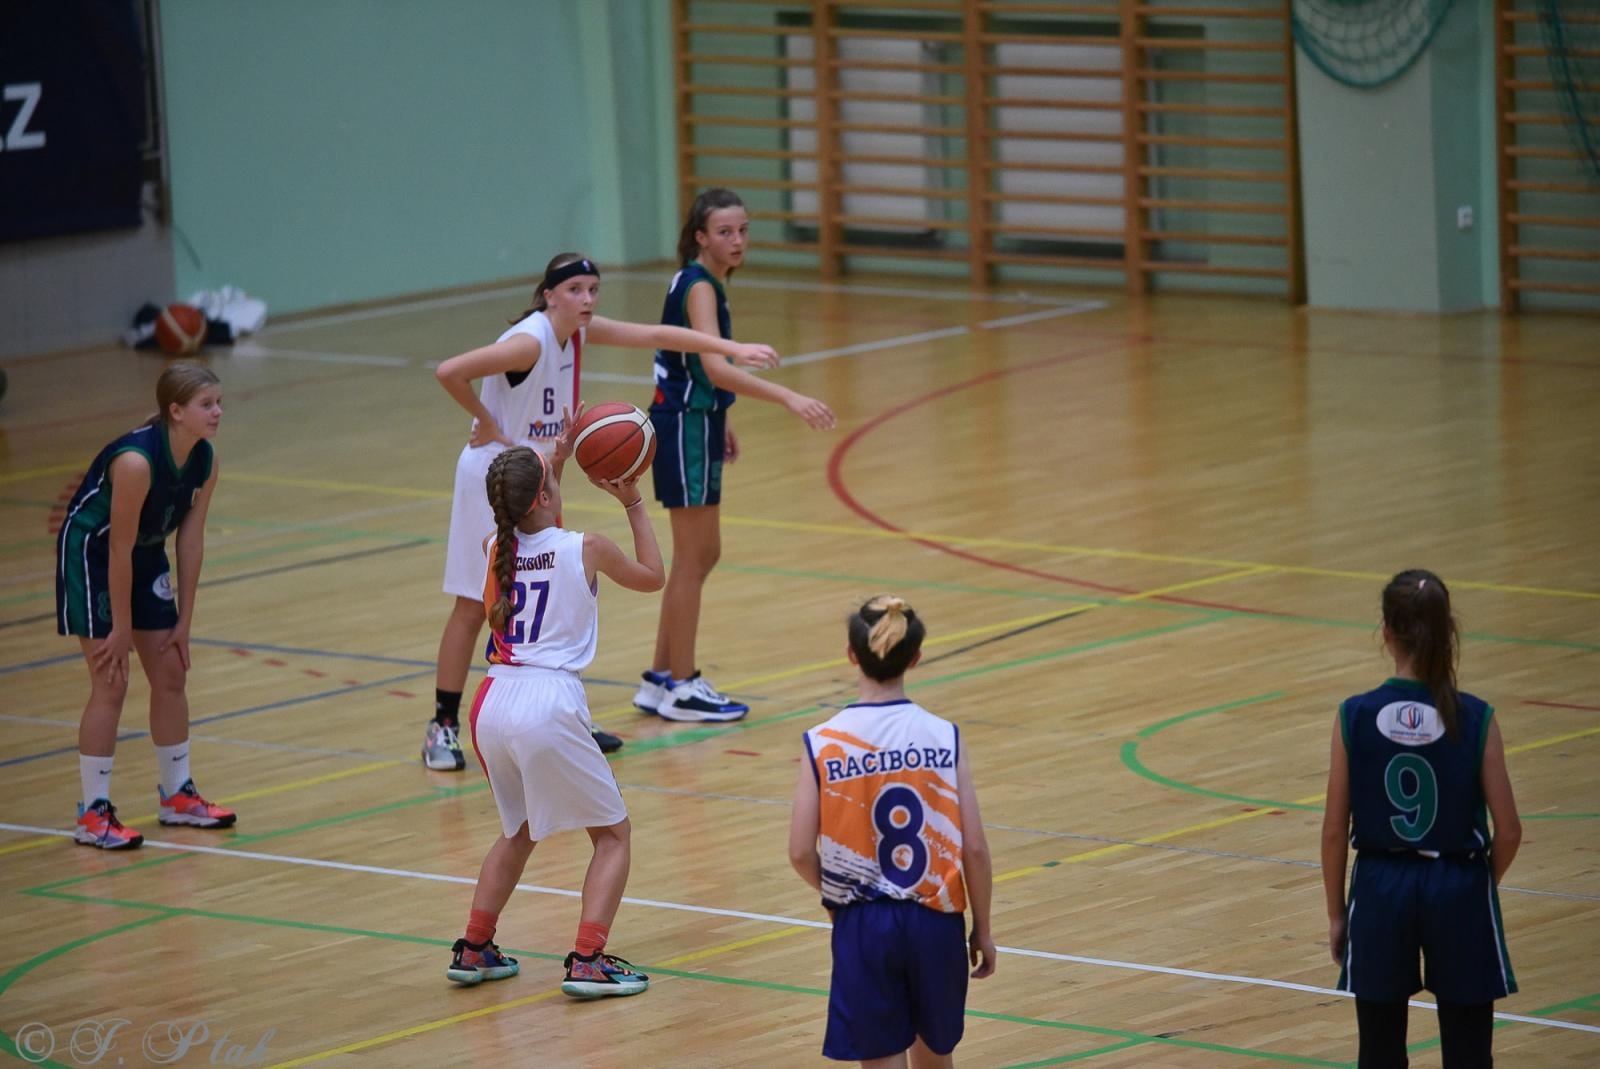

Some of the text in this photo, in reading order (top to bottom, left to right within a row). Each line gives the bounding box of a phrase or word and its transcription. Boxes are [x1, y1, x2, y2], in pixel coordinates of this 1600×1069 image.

[0, 82, 46, 151] Z
[528, 419, 565, 437] MIN
[543, 387, 555, 415] 6
[503, 580, 550, 644] 27
[826, 742, 954, 782] RACIBÓRZ
[1384, 752, 1438, 841] 9
[872, 782, 930, 891] 8
